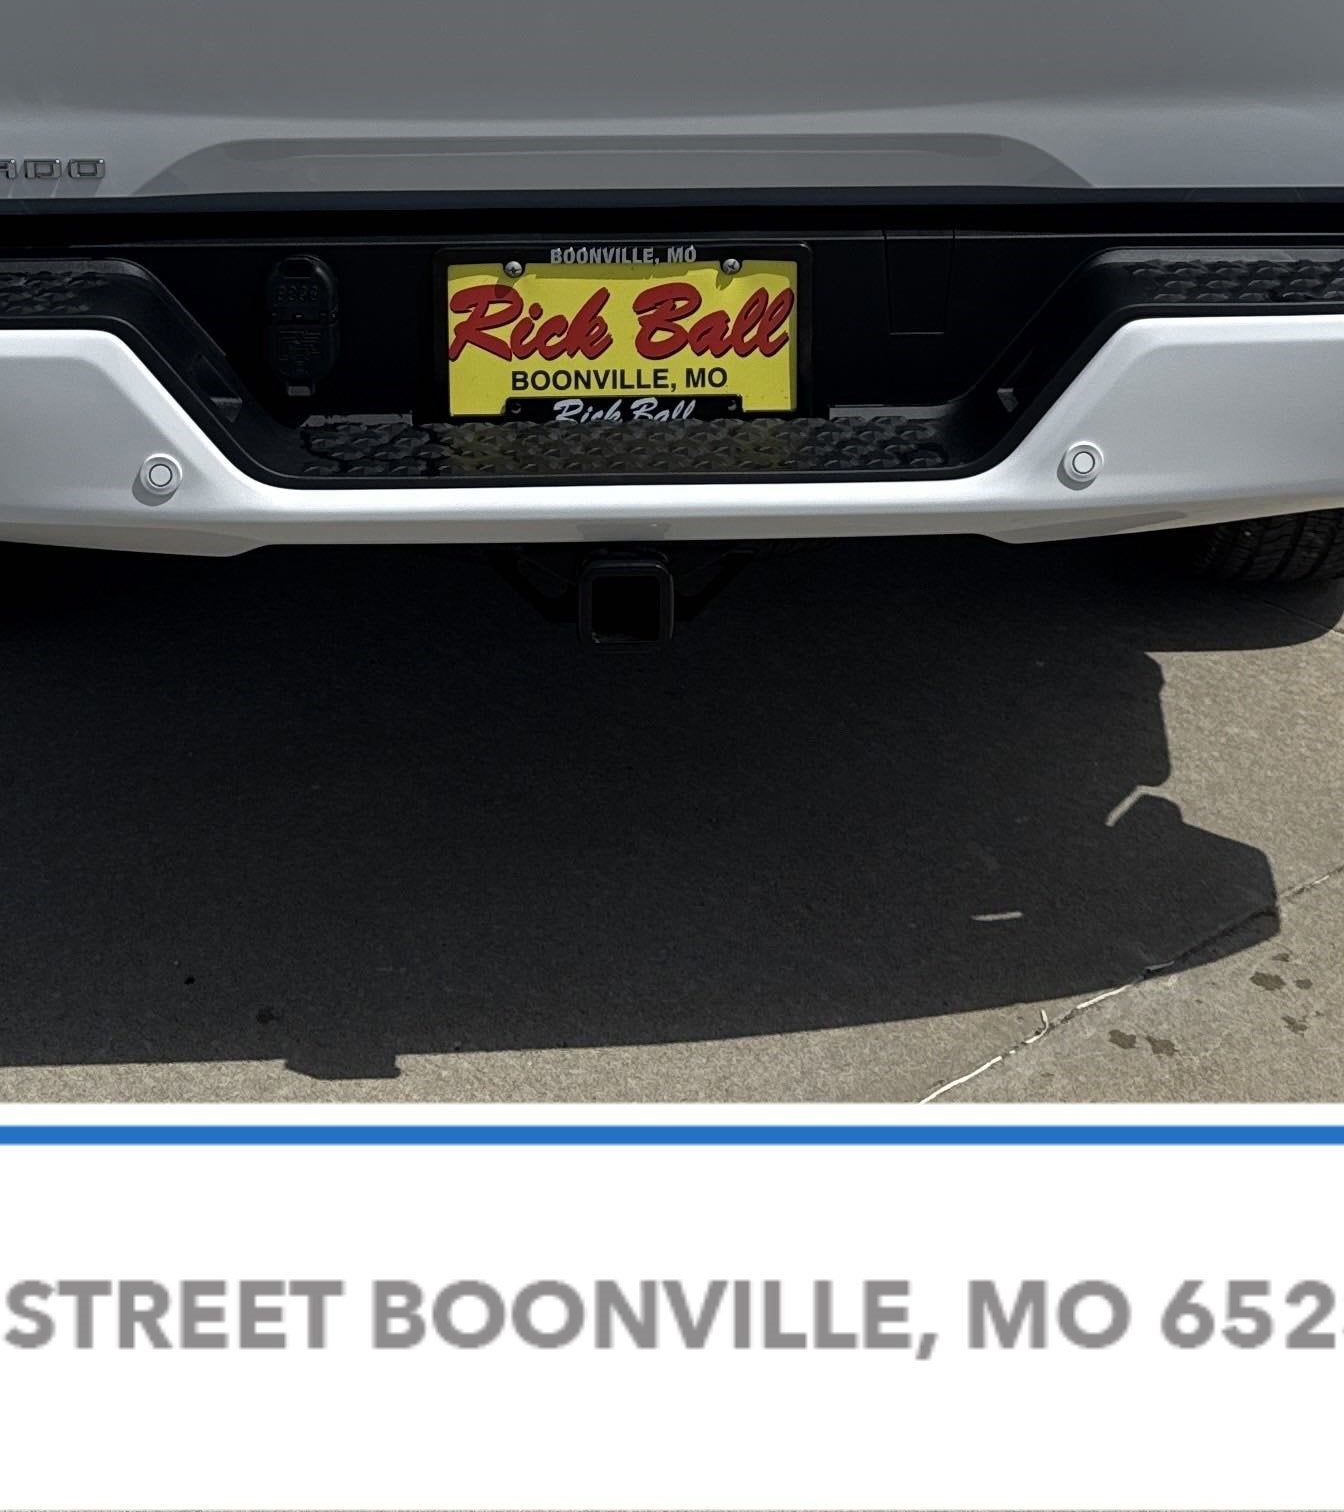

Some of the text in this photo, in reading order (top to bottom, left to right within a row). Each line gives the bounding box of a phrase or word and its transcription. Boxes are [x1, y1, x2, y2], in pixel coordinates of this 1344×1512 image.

[550, 244, 697, 265] BOONVILLE, MO
[449, 282, 795, 362] Rick Ball
[511, 367, 728, 392] BOONVILLE, MO
